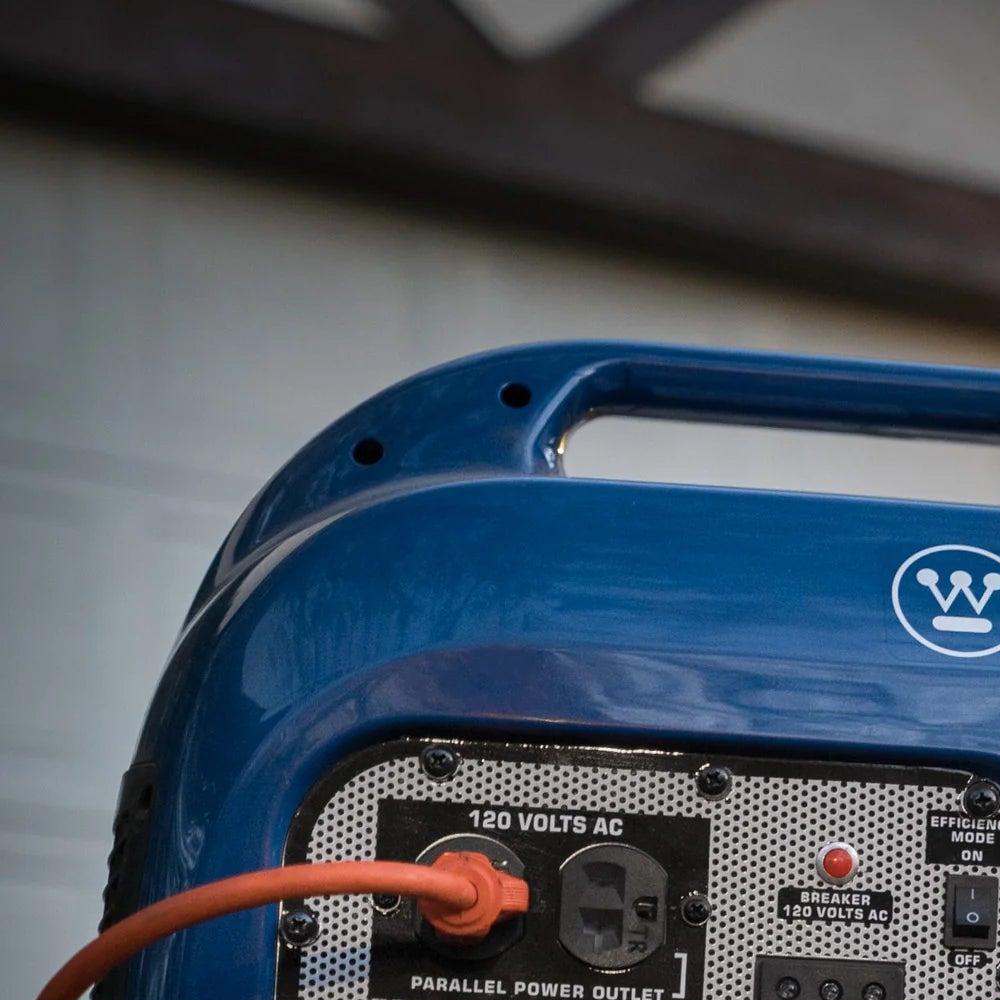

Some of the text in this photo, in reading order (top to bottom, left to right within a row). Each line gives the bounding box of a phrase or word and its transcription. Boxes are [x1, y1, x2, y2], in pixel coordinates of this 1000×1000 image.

[468, 809, 624, 837] 120 VOLTS AC
[951, 831, 995, 845] MODE
[961, 850, 983, 862] ON
[800, 891, 871, 906] BREAKER
[783, 904, 889, 922] 120 VOLTS AC
[955, 954, 981, 966] OFF
[411, 975, 507, 996] PARALLEL
[514, 981, 585, 1000] POWER
